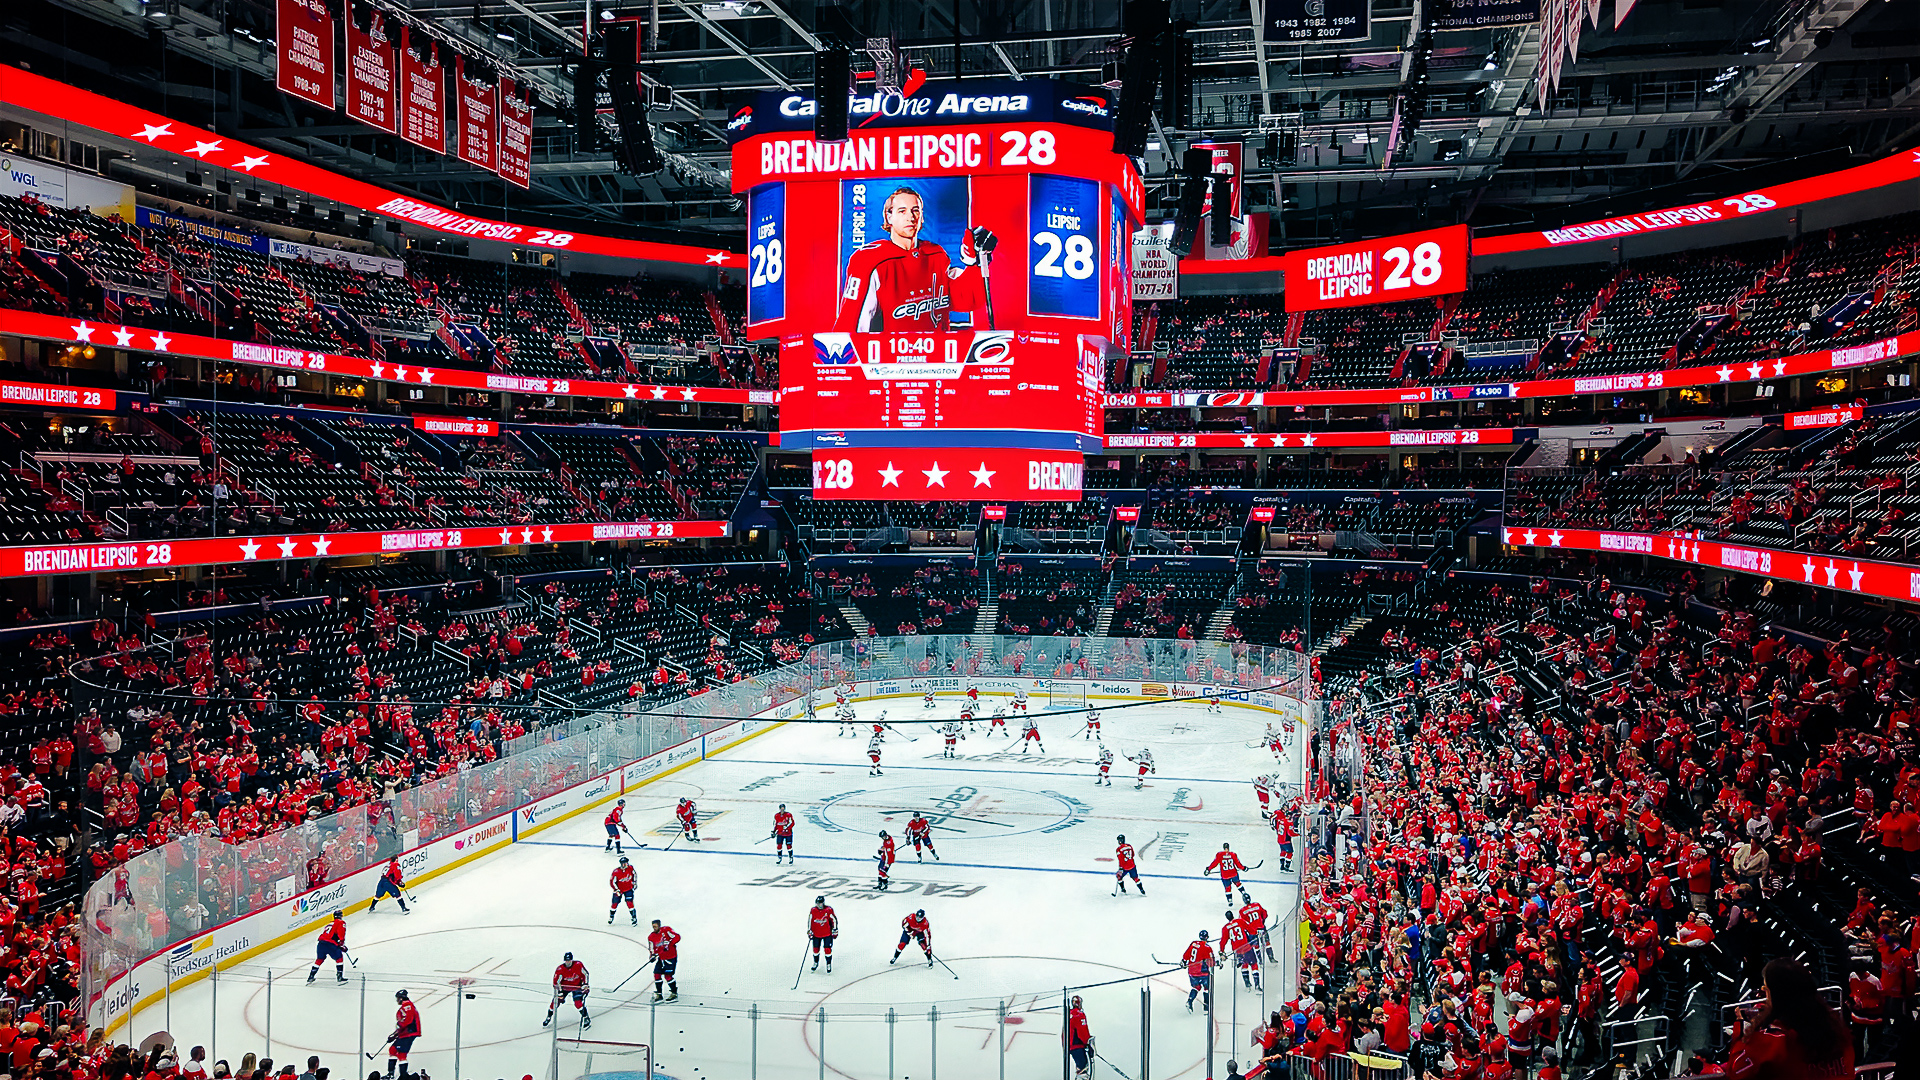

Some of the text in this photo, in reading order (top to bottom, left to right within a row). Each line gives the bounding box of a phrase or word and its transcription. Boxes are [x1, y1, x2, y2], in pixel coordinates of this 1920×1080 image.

[1333, 17, 1356, 25] 1984
[1477, 12, 1534, 24] CHAMPIONS
[293, 26, 319, 47] PATRICK
[1289, 28, 1341, 37] 1985 2007
[293, 38, 320, 60] DIVISION
[358, 45, 384, 66] EASTERN
[288, 49, 325, 74] CHAMPIONS
[353, 55, 390, 81] CONFERENCE
[354, 67, 389, 92] CHAMPIONS
[410, 92, 437, 112] CHAMPIONS
[935, 94, 1029, 114] Arena
[761, 130, 1056, 175] BRENDAN LEIPSIC 28
[11, 170, 38, 188] WGL
[376, 197, 574, 247] BRENDAN LEIPSIC 28
[852, 183, 866, 250] LEIPSIC 28
[1046, 212, 1081, 231] LEIPSIC
[1541, 194, 1777, 244] BRENDAN LEIPSIC 28
[149, 212, 164, 226] WGL
[198, 224, 223, 240] ENERGY
[223, 230, 252, 246] ANSWERS
[273, 242, 285, 253] WE
[1032, 231, 1095, 280] 28
[1145, 250, 1162, 260] NBA
[750, 238, 783, 289] 28
[1140, 259, 1168, 270] WORLD
[1307, 250, 1373, 280] BRENDAN
[1319, 241, 1442, 300] LEIPSIC 28
[1134, 283, 1173, 295] 1977-78
[232, 342, 325, 369] BRENDAN LEIPSIC 28
[868, 338, 958, 363] 0 10:40 0
[1887, 338, 1898, 356] 28
[896, 355, 927, 364] PREGAME
[487, 375, 570, 393] BRENDAN LEIPSIC 28
[1475, 387, 1502, 396] $4,900
[1613, 374, 1644, 390] LEIPSIC
[1647, 373, 1663, 387] 28
[2, 385, 101, 406] BRENDAN LEIPSIC 28
[1102, 395, 1163, 406] 10:40 PRE
[476, 423, 489, 434] 28
[1390, 431, 1479, 445] BRENDAN LEIPSIC 28
[1108, 435, 1196, 447] BRENDAN LEIPSIC 28
[824, 458, 854, 489] 28
[381, 530, 462, 549] BRENDAN LEIPSIC 28
[593, 523, 674, 538] BRENDAN LEIPSIC 28
[24, 544, 171, 571] BRENDAN LEIPSIC 28
[1761, 552, 1771, 573] 28
[1102, 684, 1131, 694] leidos
[475, 820, 509, 844] DUNKIN'
[401, 848, 429, 872] pepsi
[1222, 859, 1234, 871] 33
[308, 883, 348, 912] Sports
[1229, 926, 1244, 942] 43
[171, 936, 250, 980] MedStar Health
[1190, 948, 1198, 963] 9
[107, 982, 140, 1018] leidos
